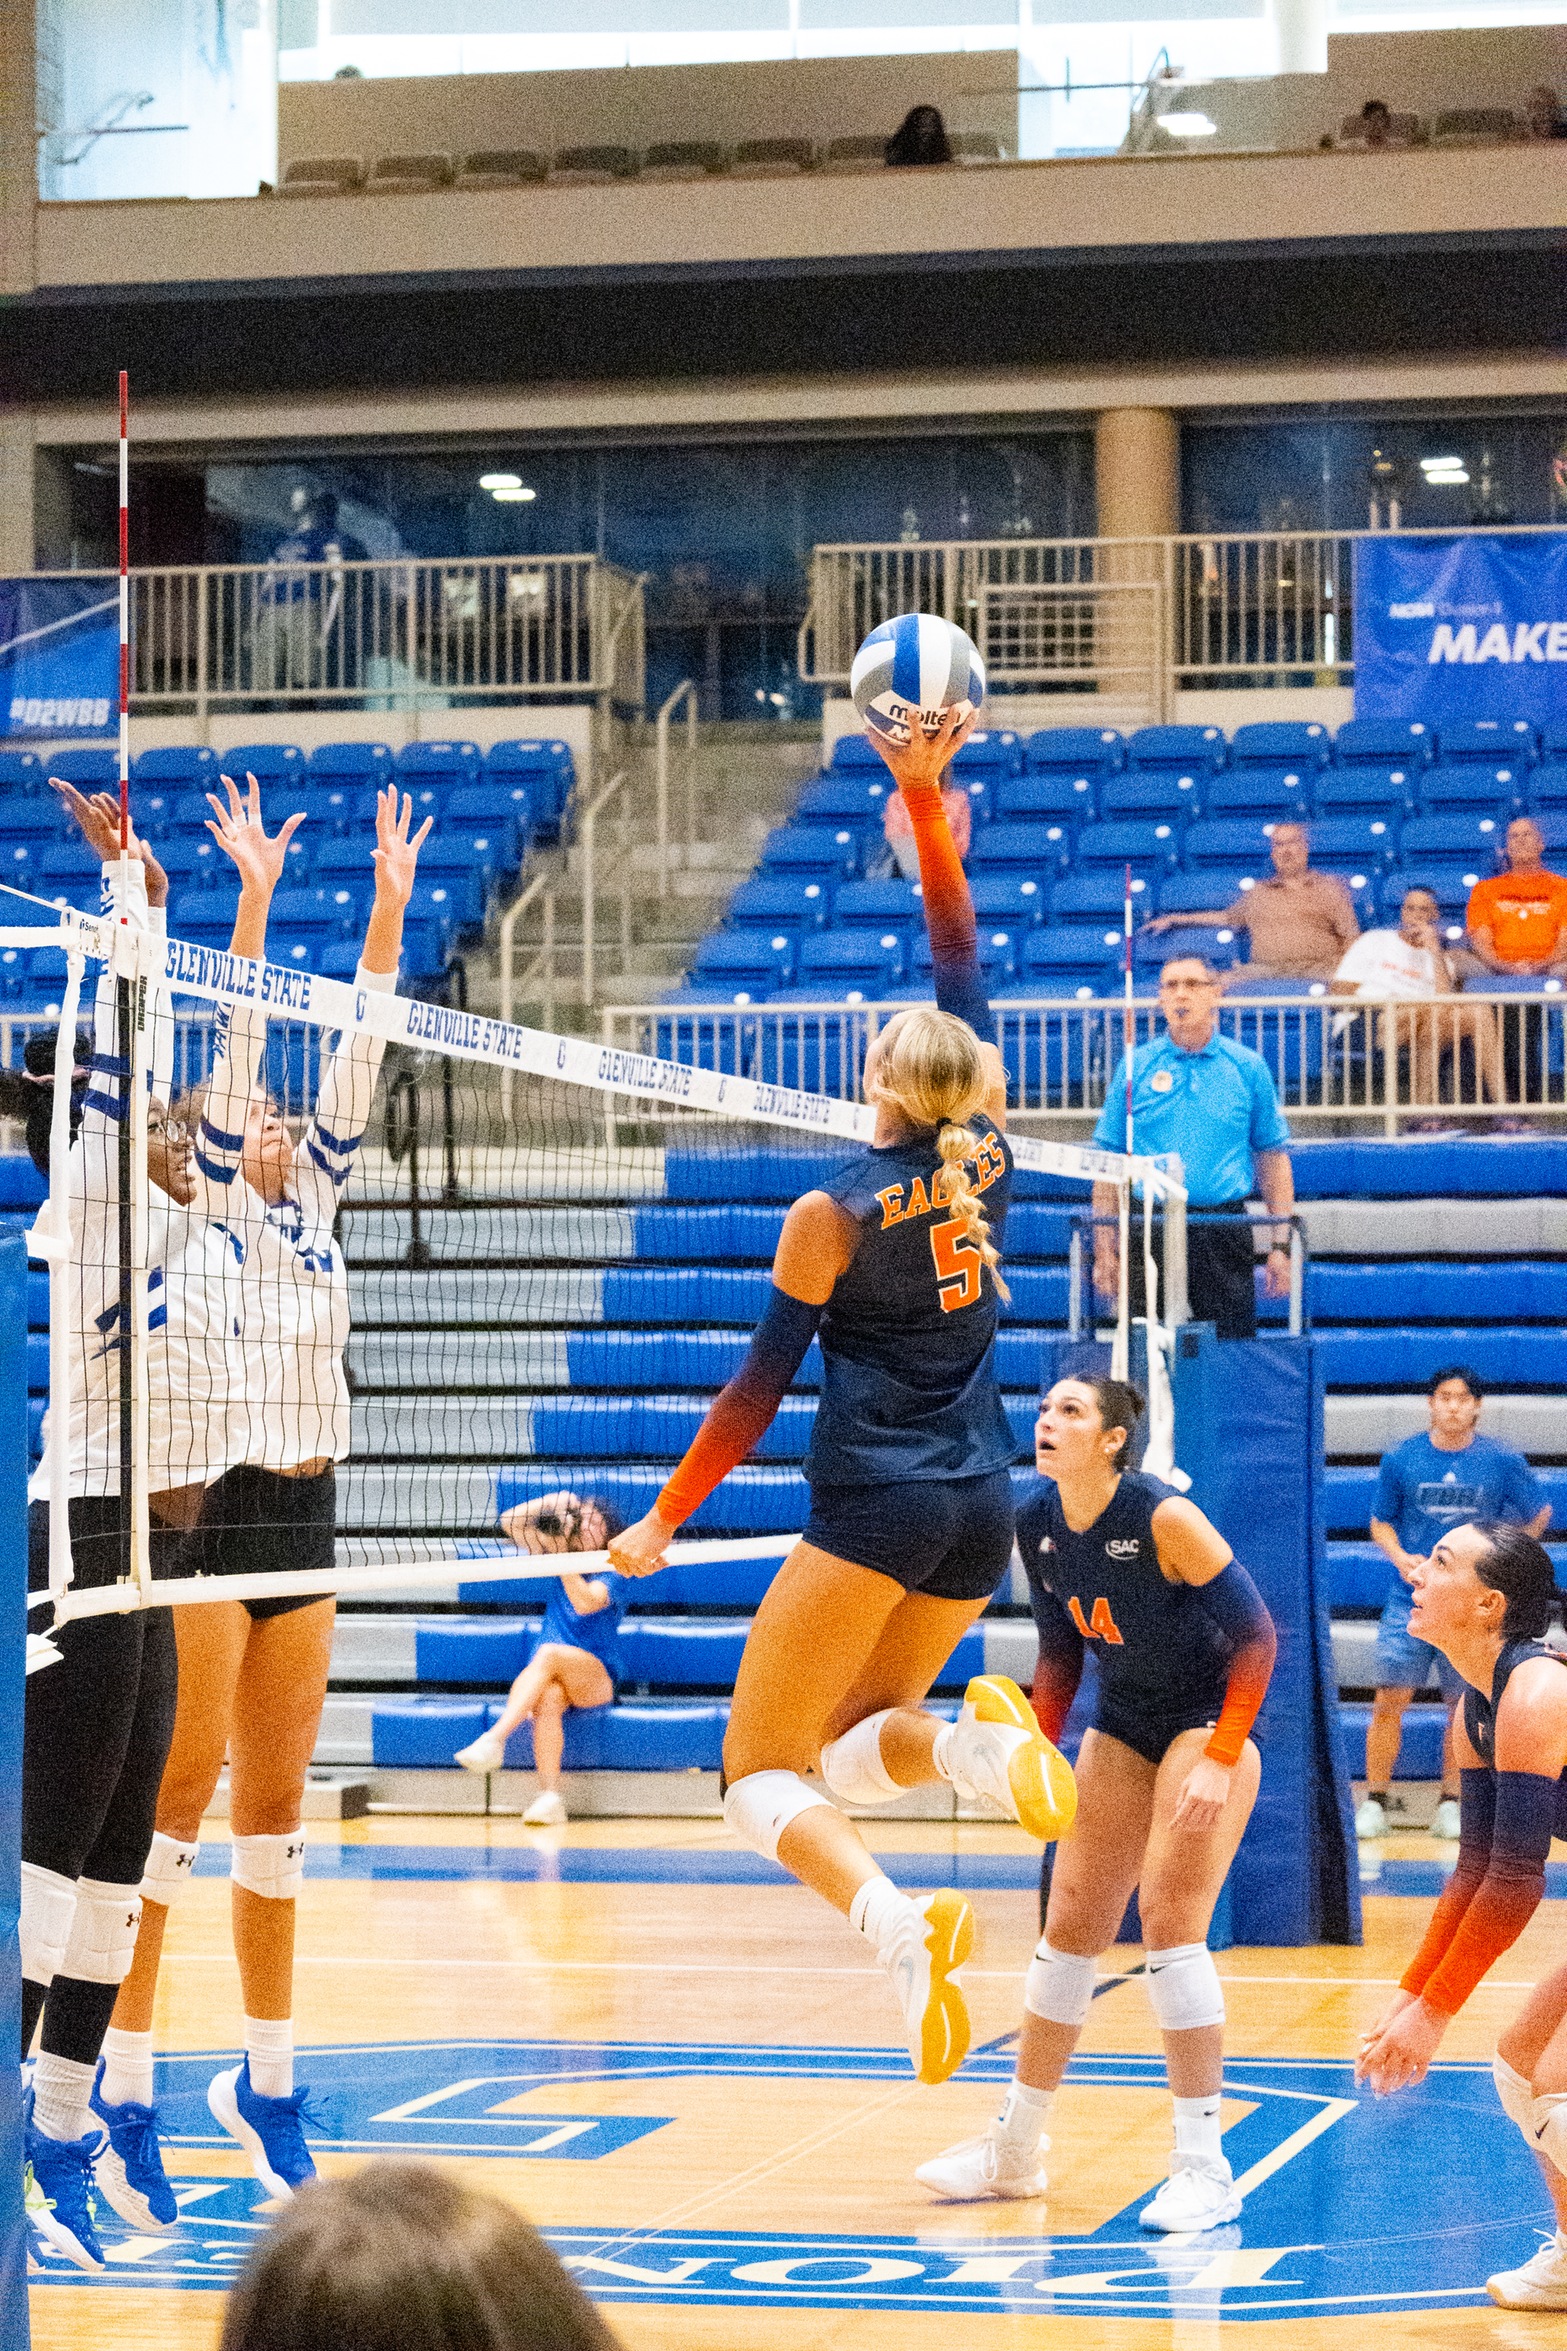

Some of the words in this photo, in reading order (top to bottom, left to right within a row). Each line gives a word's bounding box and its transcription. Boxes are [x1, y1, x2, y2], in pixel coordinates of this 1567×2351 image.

[889, 703, 961, 727] mlte
[165, 940, 257, 998] GLENVILLE
[260, 964, 313, 1011] STATE
[406, 1001, 481, 1050] GLENVILLE
[483, 1022, 523, 1059] STATE
[598, 1049, 657, 1090] GLENVILLE
[658, 1062, 693, 1097] STATE
[930, 1216, 983, 1314] 5
[1110, 1538, 1140, 1554] SAC
[1067, 1596, 1125, 1646] 14
